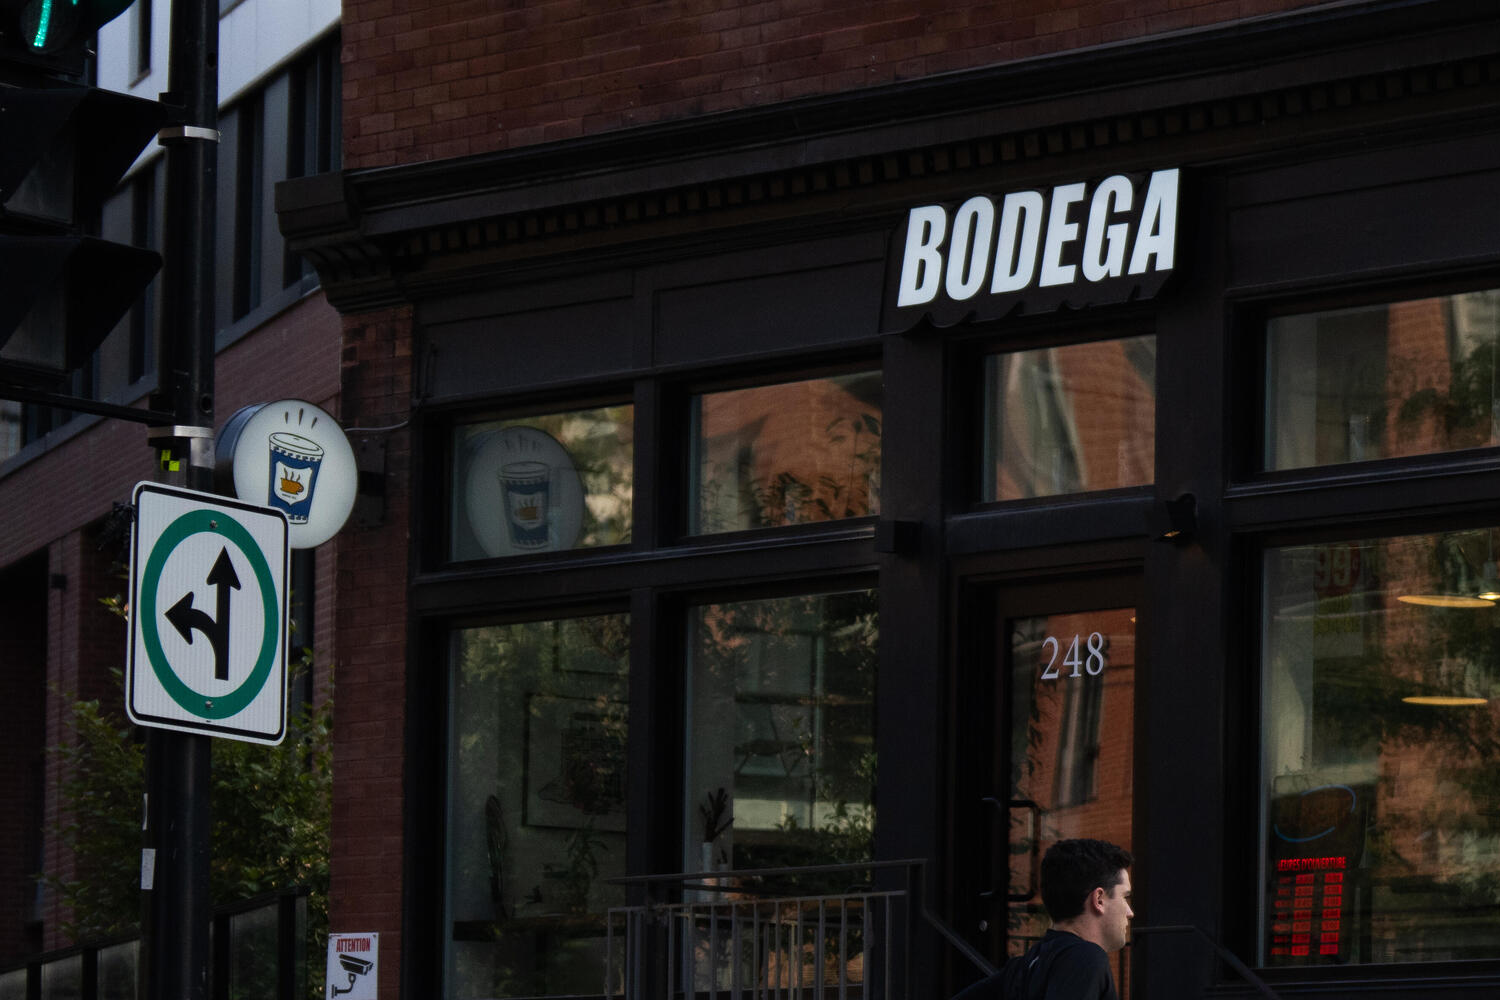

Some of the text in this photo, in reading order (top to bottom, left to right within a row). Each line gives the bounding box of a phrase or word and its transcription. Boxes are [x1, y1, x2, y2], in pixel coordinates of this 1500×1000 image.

[897, 168, 1180, 307] BODEGA
[1040, 631, 1104, 680] 248
[336, 938, 371, 952] ATTENTION
